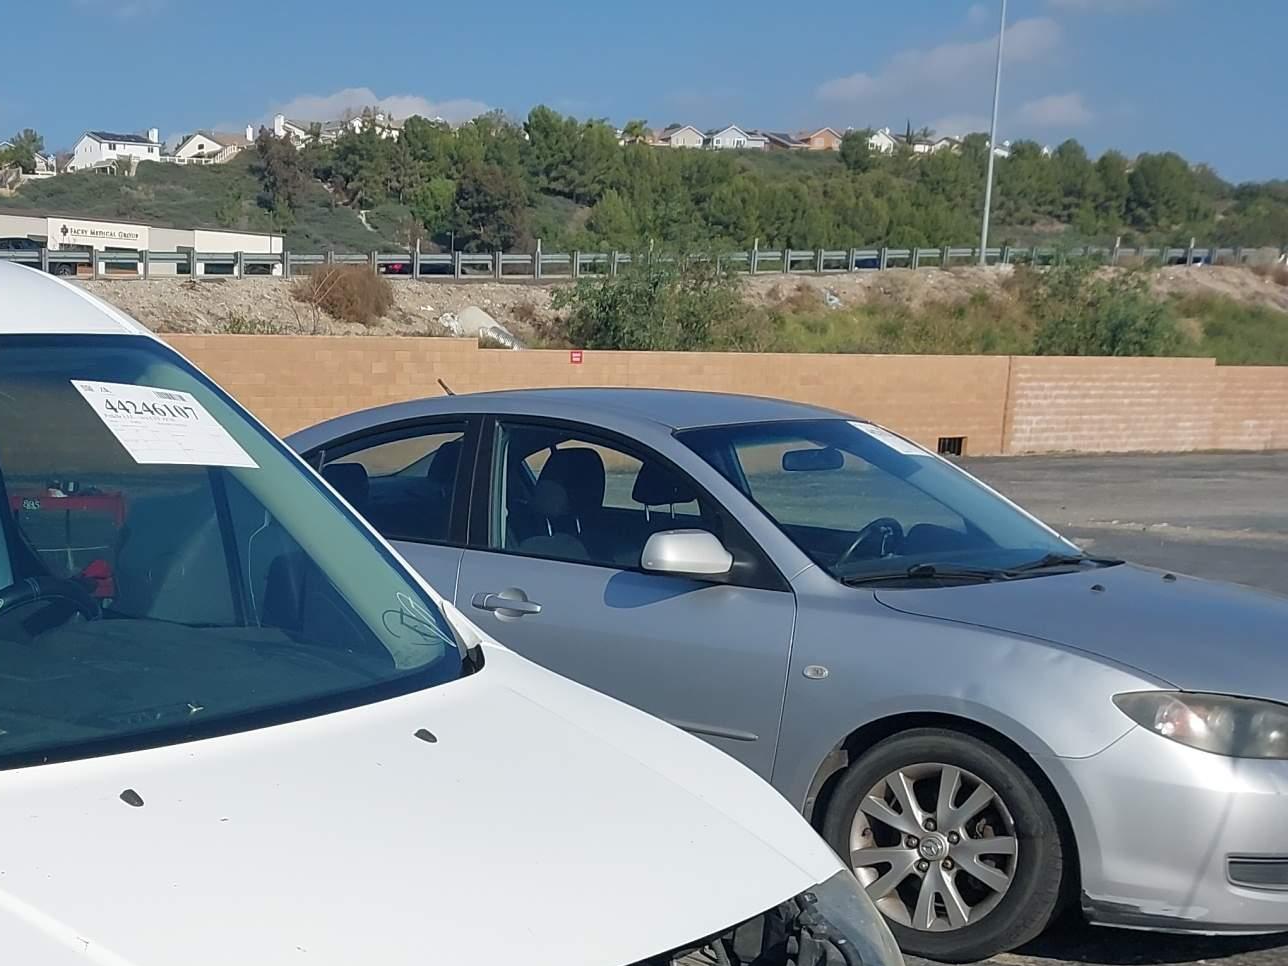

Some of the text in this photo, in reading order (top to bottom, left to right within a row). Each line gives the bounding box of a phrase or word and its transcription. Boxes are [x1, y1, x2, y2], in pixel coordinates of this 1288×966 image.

[90, 229, 116, 237] MEDICAL
[118, 231, 139, 239] GROUP
[104, 396, 200, 421] 44246107
